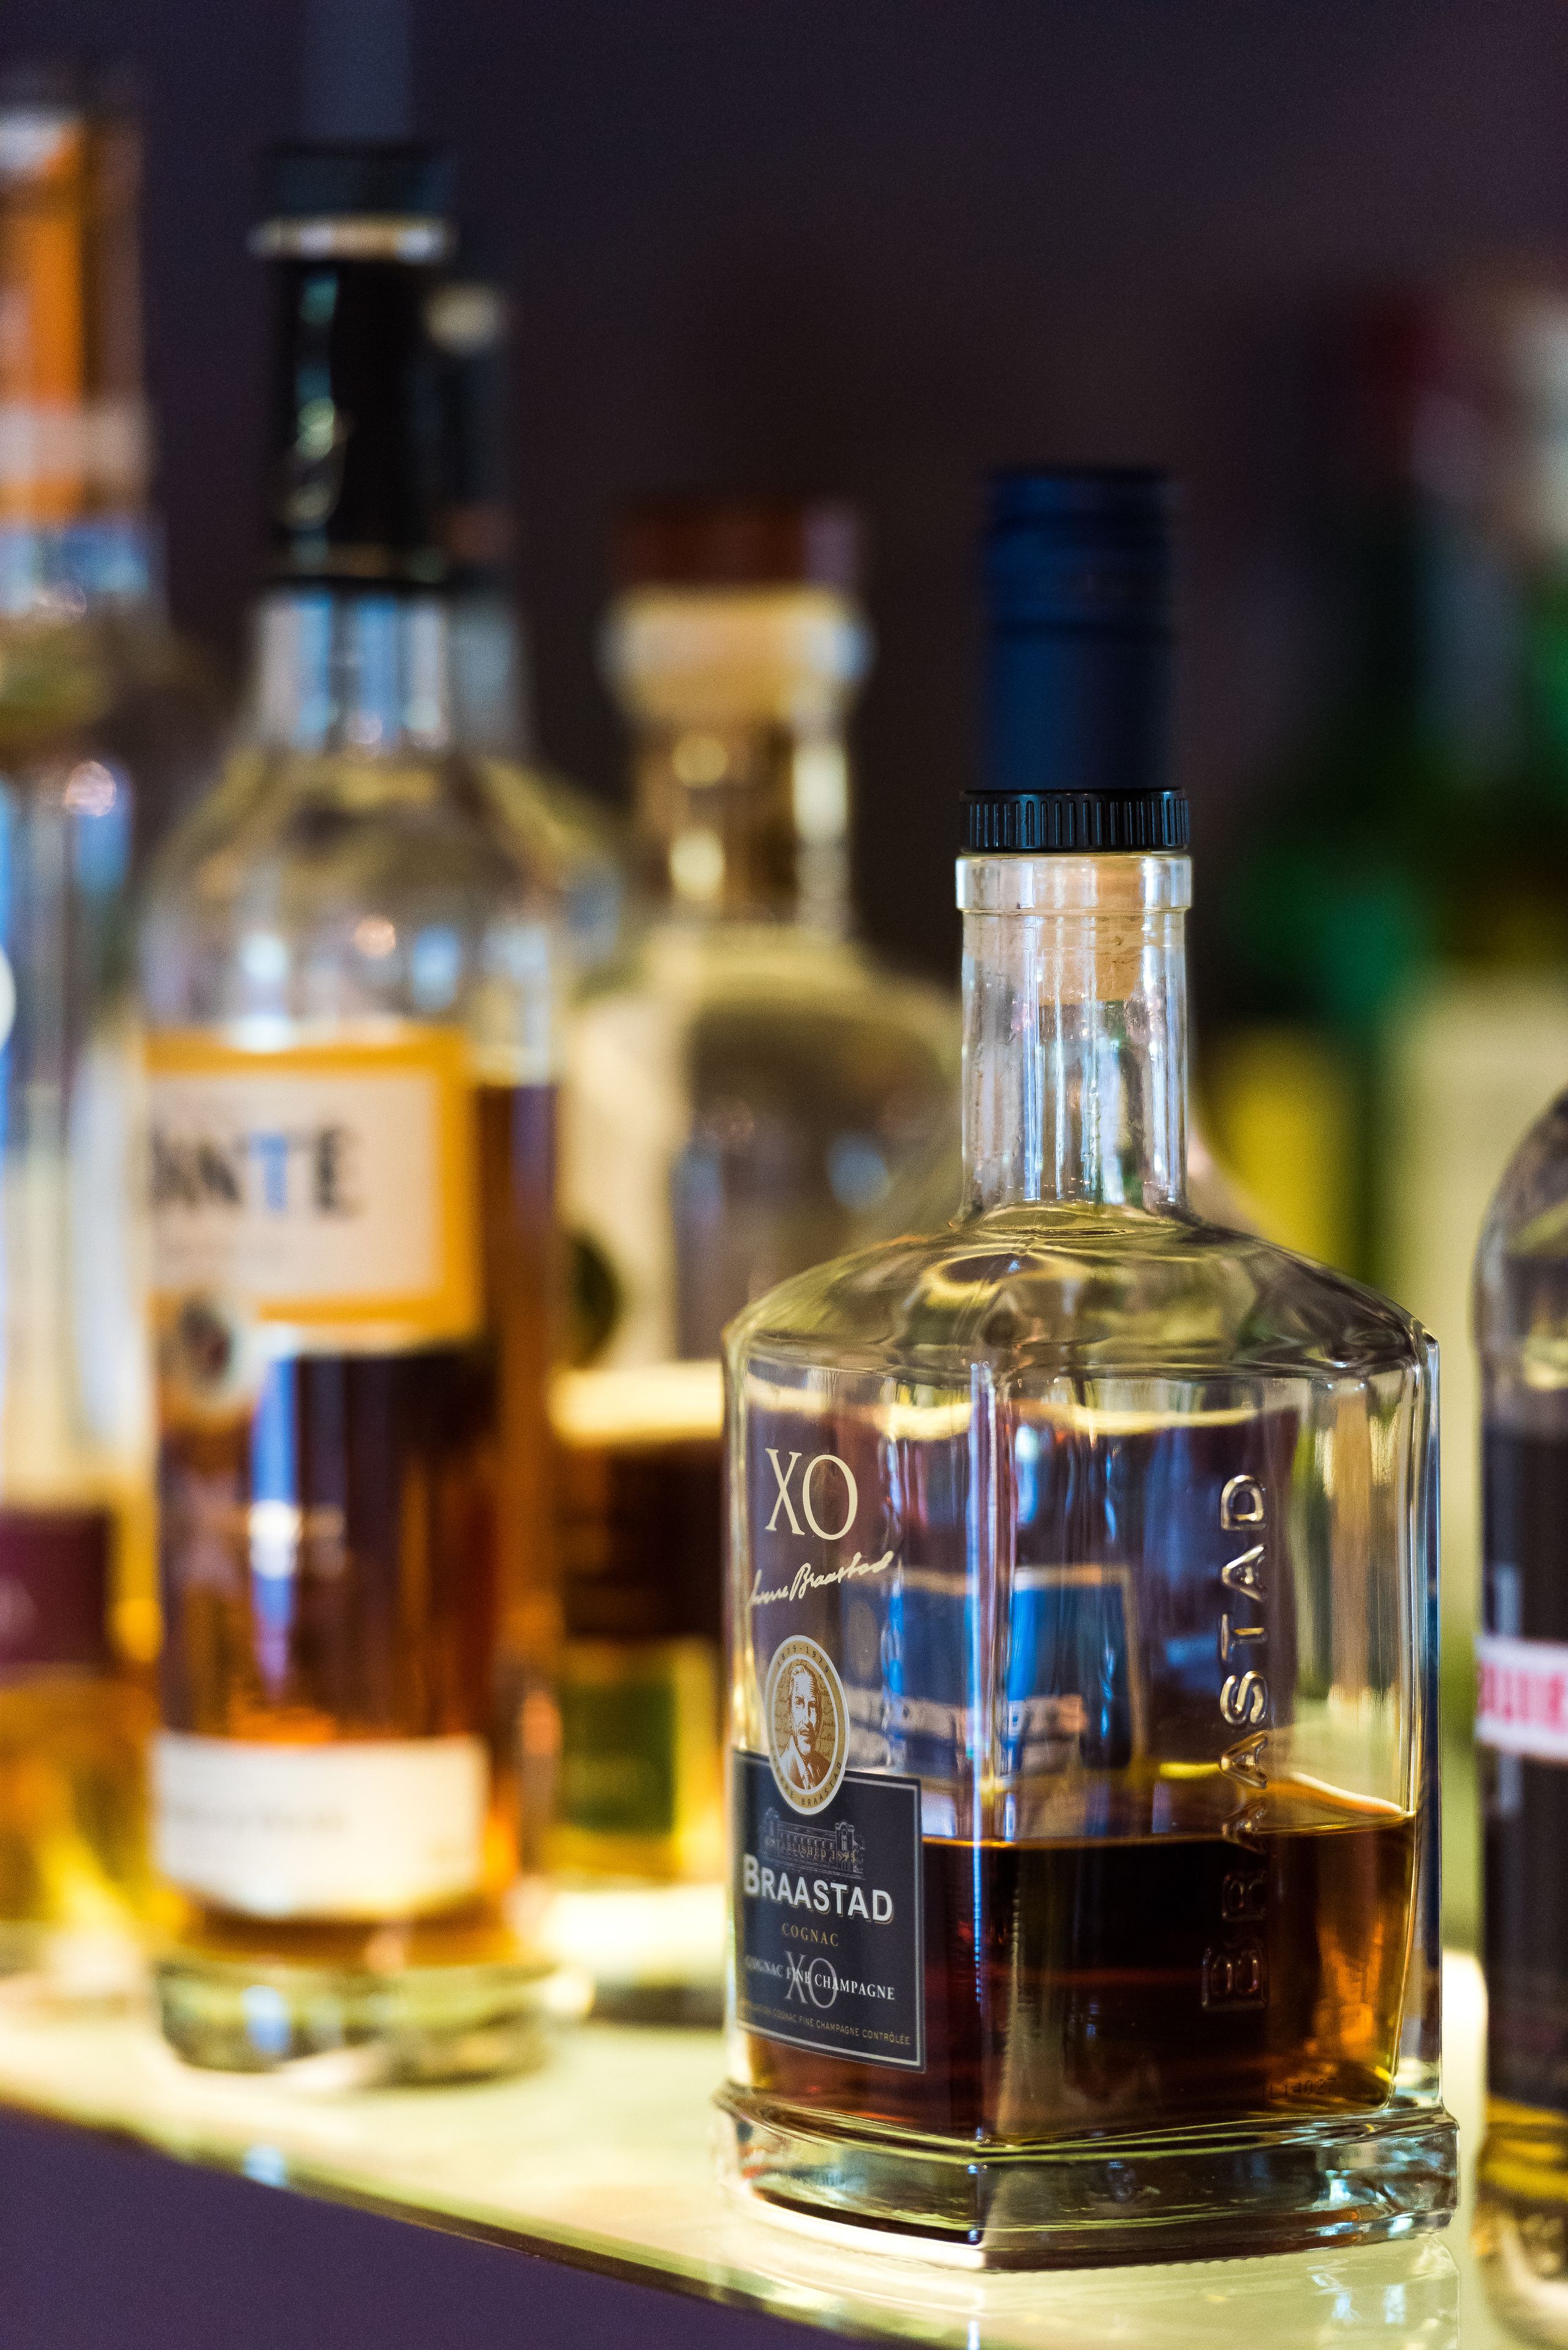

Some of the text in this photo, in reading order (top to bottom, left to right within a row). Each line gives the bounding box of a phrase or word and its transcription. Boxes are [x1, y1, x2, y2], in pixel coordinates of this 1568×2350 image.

[765, 1448, 858, 1540] XO
[1200, 1474, 1267, 2011] BRAASTAD
[801, 1762, 842, 1806] BRAASTAD
[744, 1854, 894, 1923] BRAASTAD
[782, 1923, 839, 1947] COGNAC
[785, 1950, 838, 2008] XO
[814, 1974, 895, 2001] CHAMPAGNE
[816, 2020, 859, 2037] CHAMPAGNE
[862, 2029, 911, 2045] CONTRÔLÉE
